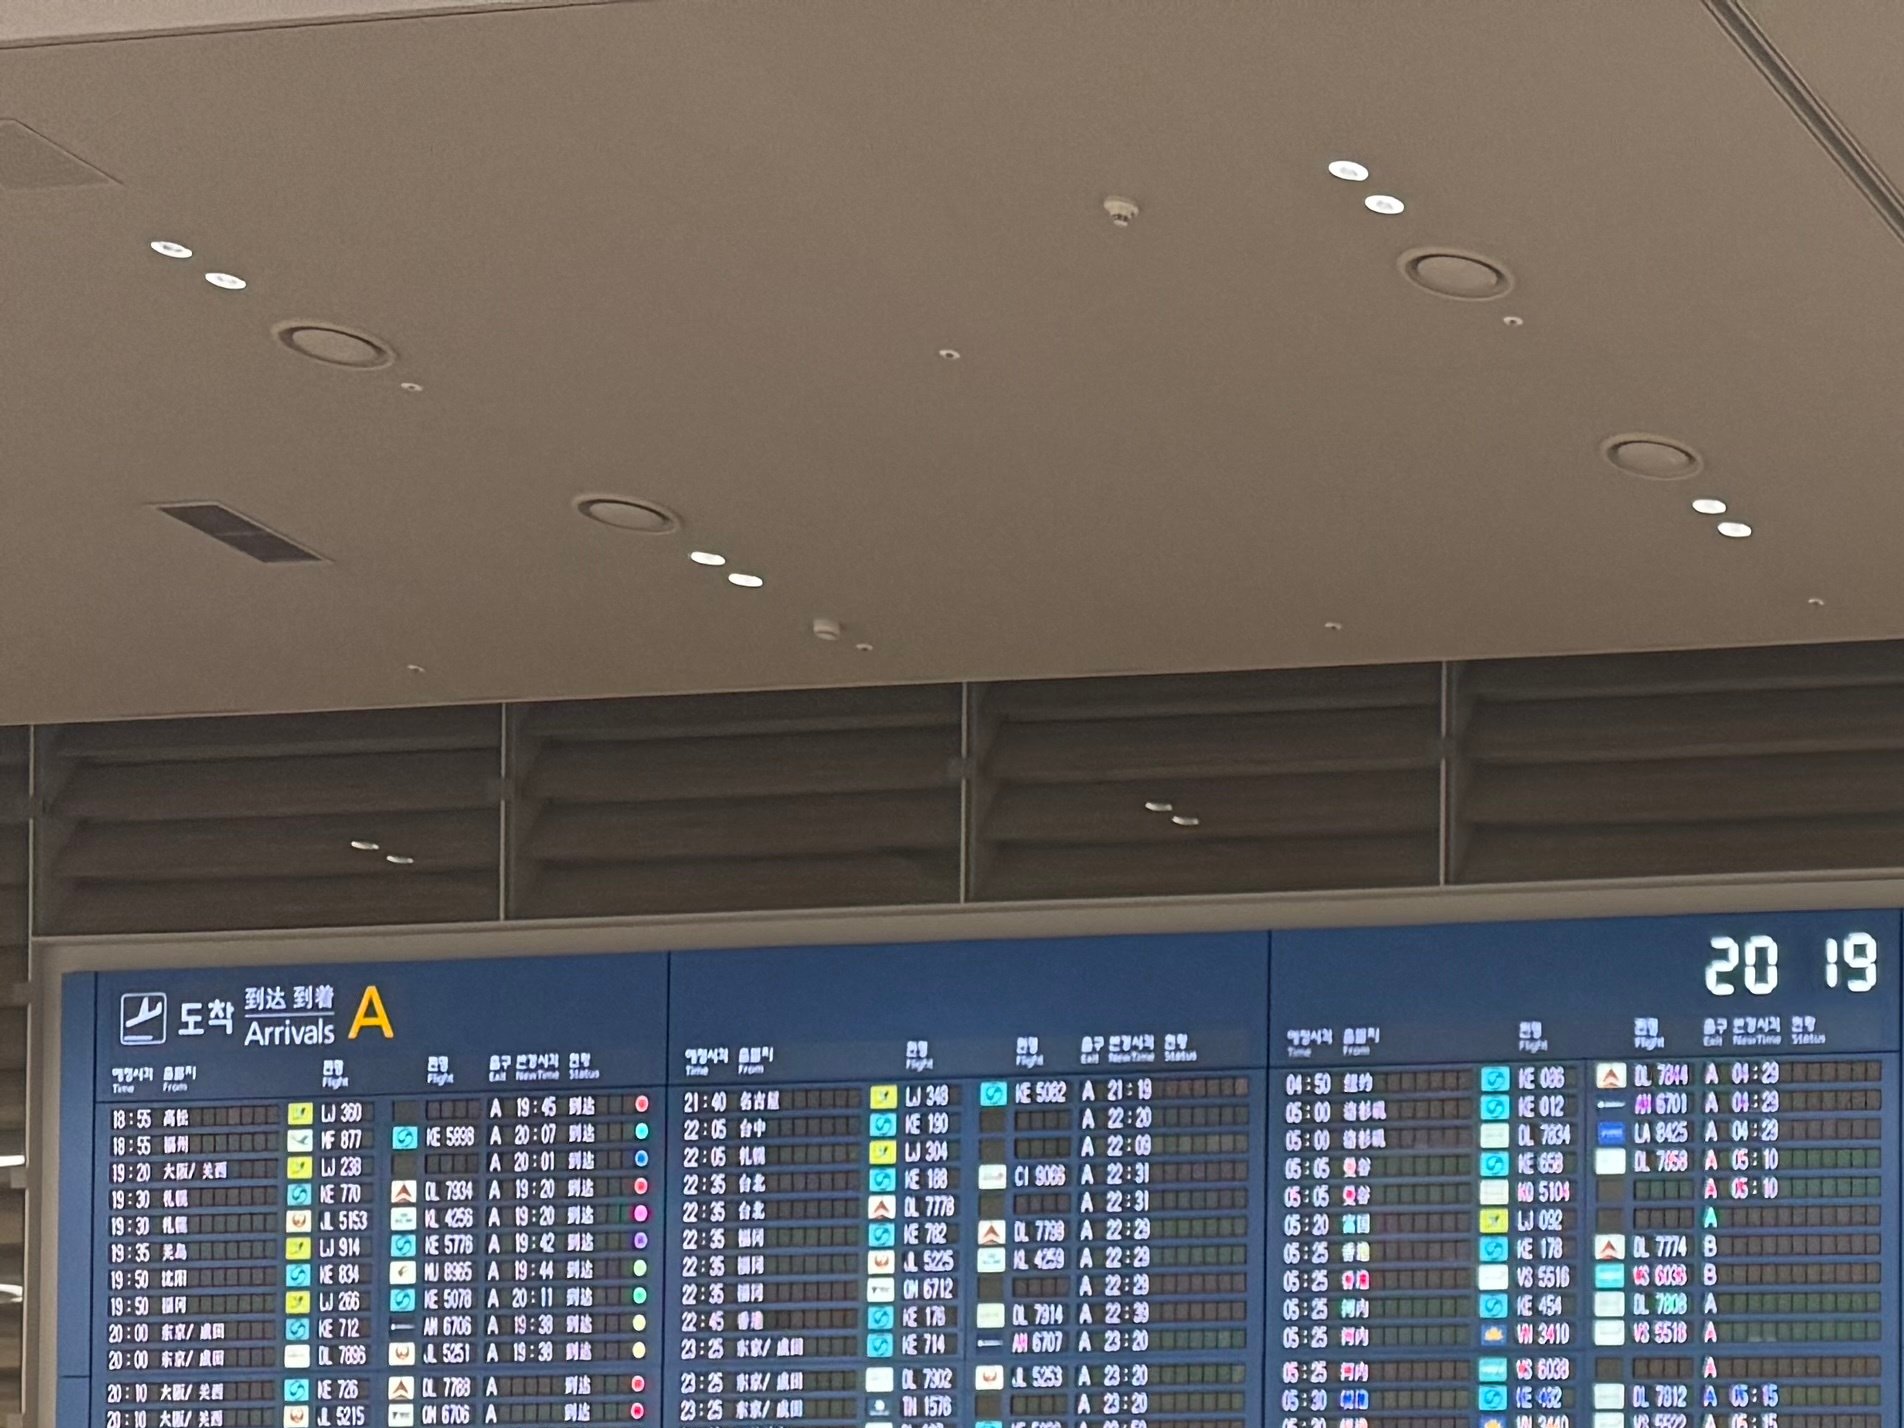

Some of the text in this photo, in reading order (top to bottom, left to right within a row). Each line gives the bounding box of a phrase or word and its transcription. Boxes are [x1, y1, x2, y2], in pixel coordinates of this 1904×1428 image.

[1705, 932, 1878, 996] 20 19
[245, 986, 286, 1010] 到达
[348, 985, 394, 1039] A
[178, 998, 235, 1035] 도착
[244, 1018, 335, 1046] Arrivals
[1287, 1063, 1718, 1095] 04:50 A
[685, 1092, 726, 1112] 21:40
[1082, 1081, 1094, 1101] A
[1286, 1102, 1330, 1123] 05:00
[1705, 1092, 1718, 1113] A
[114, 1110, 151, 1129] 18:55
[490, 1098, 501, 1117] A
[517, 1096, 556, 1117] 19:45
[684, 1119, 726, 1140] 22:05
[906, 1113, 920, 1134] KE
[1082, 1108, 1094, 1129] A
[1108, 1106, 1151, 1128] 22:20
[113, 1163, 150, 1182] 19:20
[490, 1153, 500, 1171] A
[515, 1152, 554, 1171] 20:01
[684, 1174, 725, 1194] 22:35
[1107, 1163, 1149, 1184] 22:31
[112, 1179, 554, 1209] 19:30 KE 770 A 19:20
[1284, 1242, 1328, 1263] 05:25
[1704, 1235, 1717, 1257] B
[112, 1270, 148, 1289] 19:50
[320, 1265, 333, 1284] KE
[109, 1318, 359, 1343] 20:00 KE 712
[682, 1330, 1148, 1359] 23:25 KE 714 6707 A 23:20
[1283, 1326, 1327, 1348] 05:25
